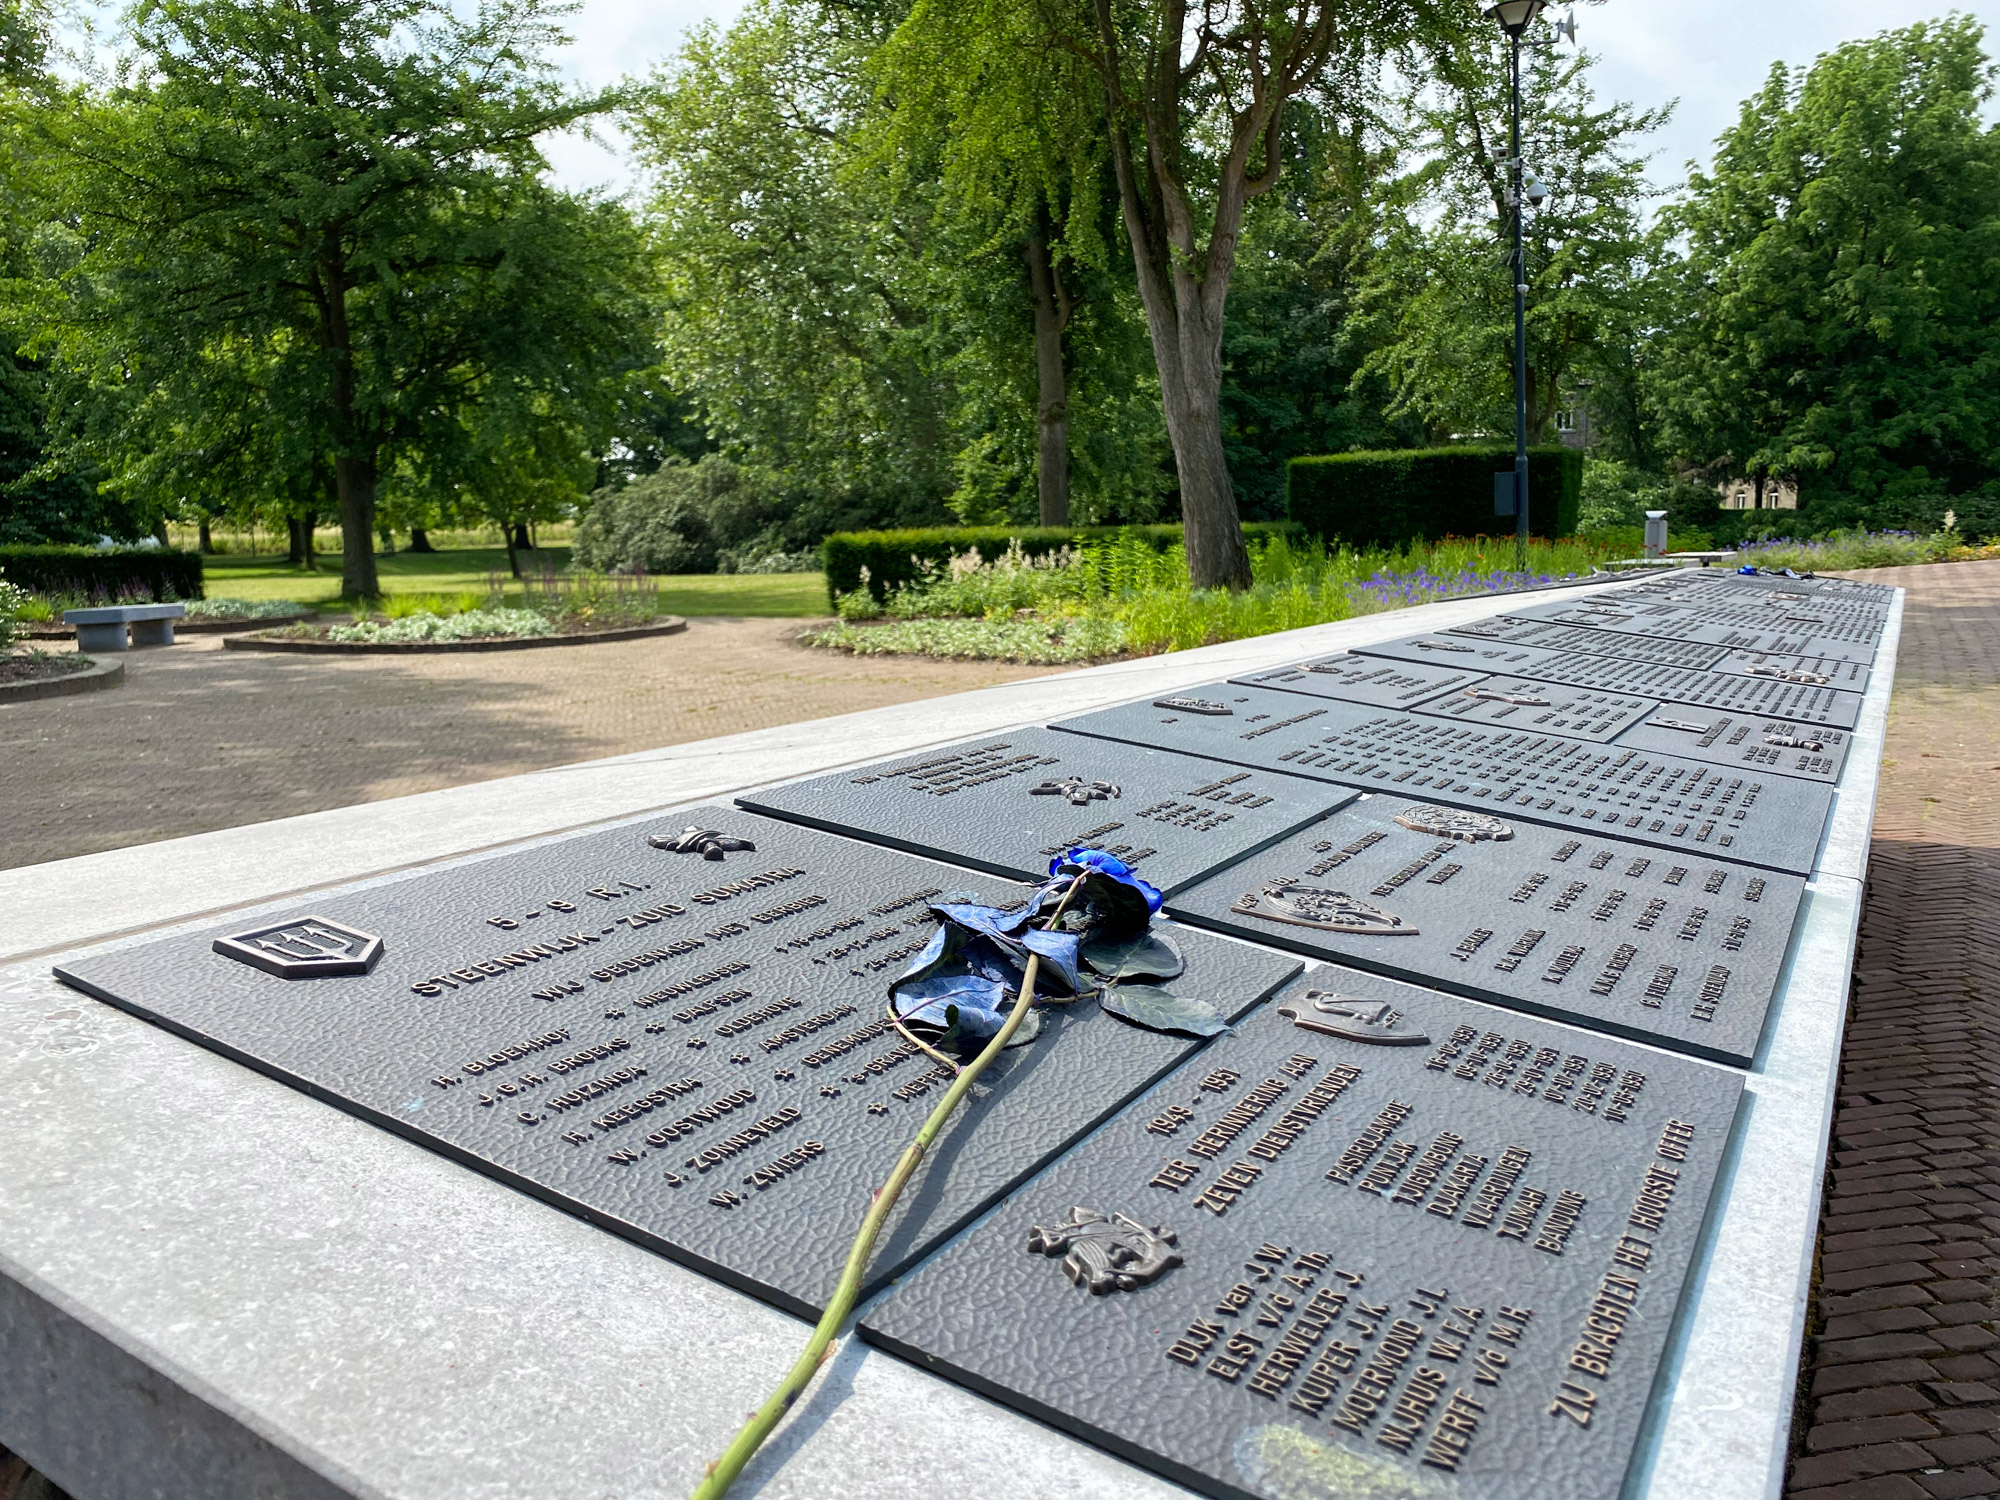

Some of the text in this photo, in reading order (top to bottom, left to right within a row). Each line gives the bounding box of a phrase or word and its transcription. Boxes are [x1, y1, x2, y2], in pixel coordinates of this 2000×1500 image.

[531, 894, 827, 1001] WIJ GEDENKEN MET EERBIED
[586, 881, 651, 900] R.I.
[691, 864, 806, 904] SUMATRA
[1456, 927, 1493, 953] BAKKER
[1605, 943, 1638, 971] RICHARD
[431, 1073, 463, 1090] H.
[462, 1026, 571, 1076] BLOEMHOF
[633, 959, 751, 1008] NIEUWLEUSEN
[517, 1110, 548, 1126] C.
[545, 1064, 648, 1114] HUIZINGA
[715, 995, 802, 1037] OLDEHOVE
[547, 1037, 631, 1075] BROEKS
[672, 987, 752, 1024] DALFSEN
[561, 1001, 858, 1146] H. KEEGSTRA AMSTERDAM
[608, 1146, 648, 1166] W.
[646, 1087, 757, 1148] OOSTWOUD
[664, 1041, 922, 1188] J. ZONNEVELD 's-GRAVE
[708, 1065, 956, 1208] W. ZWIERS MEPPE
[1145, 1104, 1194, 1138] 1949
[1199, 1067, 1242, 1093] 1951
[1149, 1052, 1319, 1193] TER HERINNERING AAN
[1193, 1062, 1363, 1217] ZEVEN DIENSTVRIENDEN
[1165, 1316, 1225, 1368] DIJK
[1215, 1282, 1256, 1317] van
[1206, 1328, 1264, 1383] ELST
[1357, 1138, 1419, 1197] PUNTJAK
[1245, 1287, 1349, 1401] HERWEIJER
[1334, 1269, 1366, 1289] J.
[1391, 1130, 1464, 1206] TJIGOMBONG
[1288, 1339, 1362, 1419] KUIPER
[1425, 1153, 1490, 1220] DJAKARTA
[1330, 1318, 1423, 1437] MOERMOND
[1460, 1145, 1533, 1229] VLAARDINGEN
[1549, 1117, 1695, 1430] ZIJ BRACHTEN HET HOOGSTE OFFER
[1420, 1387, 1487, 1473] WERFF
[1533, 1188, 1587, 1256] BANDUNG
[1375, 1365, 1447, 1456] NIJHUIS
